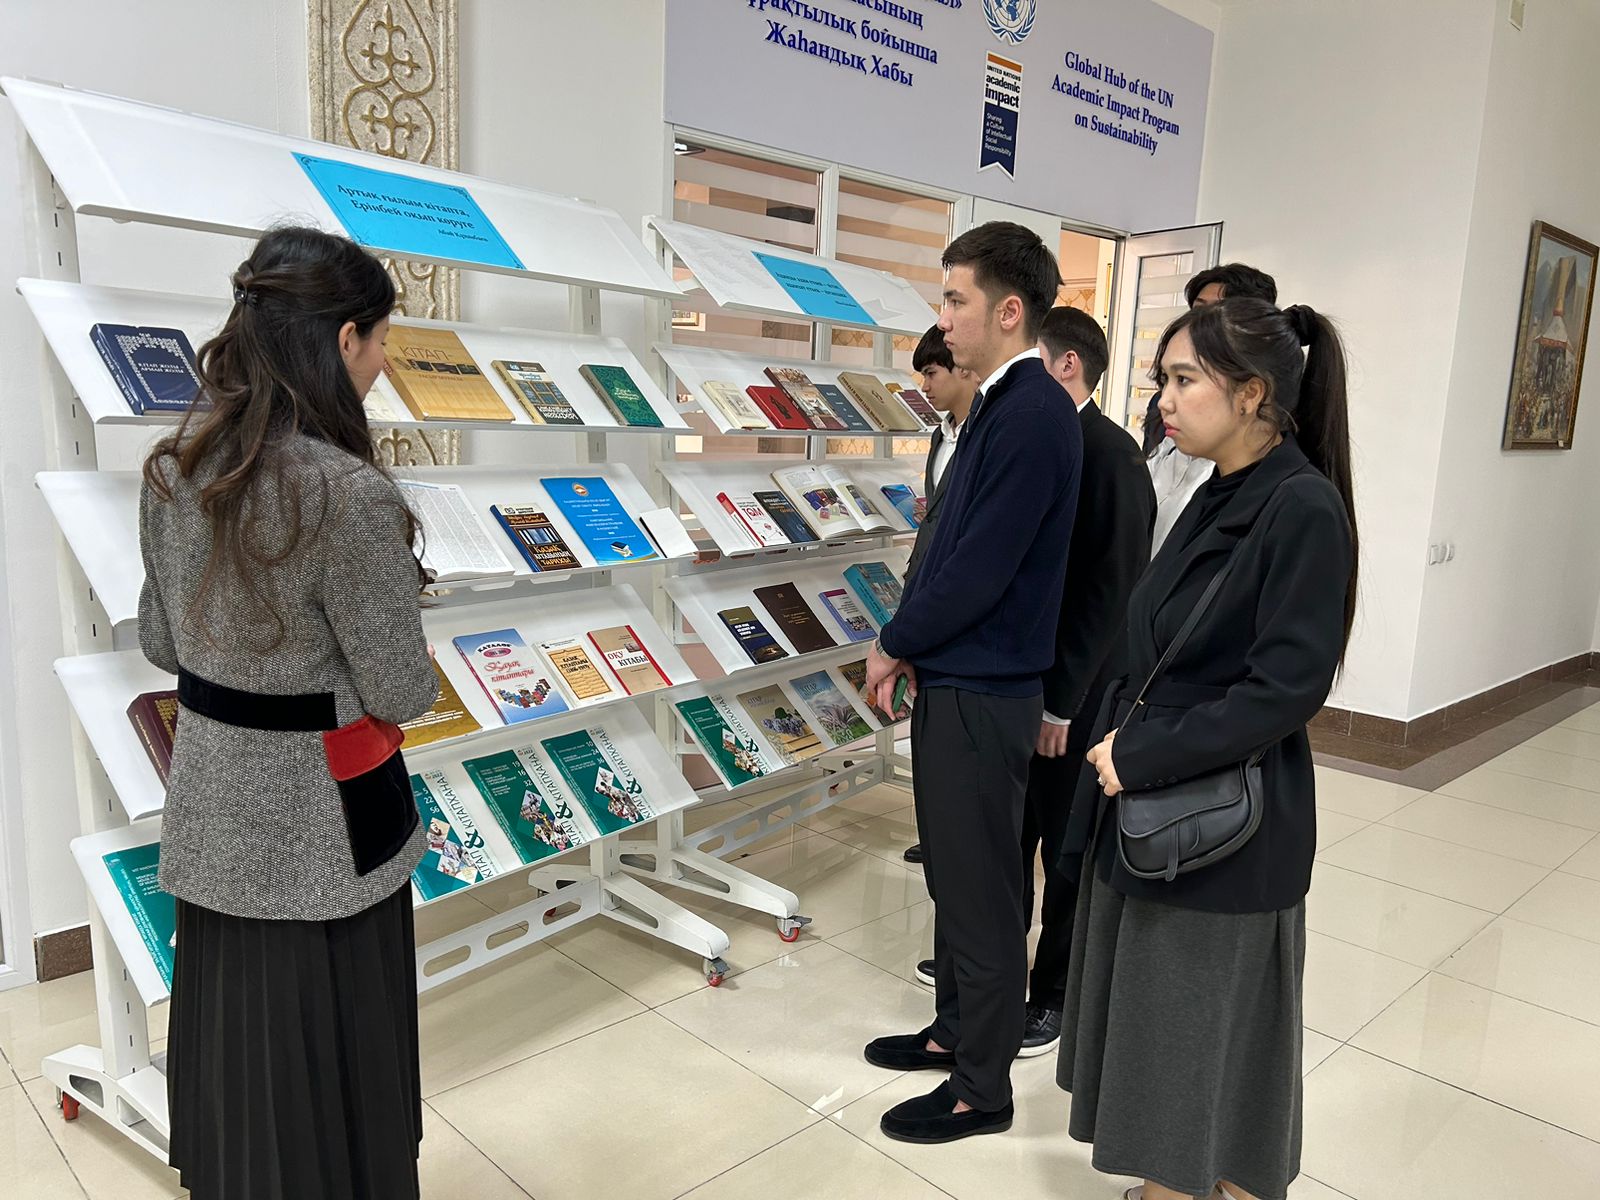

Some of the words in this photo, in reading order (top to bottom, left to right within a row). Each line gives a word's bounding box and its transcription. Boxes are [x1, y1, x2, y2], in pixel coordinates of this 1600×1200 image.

[764, 19, 867, 75] Жаһандық
[870, 54, 914, 87] Хабы
[861, 19, 938, 64] бойынша
[986, 74, 1021, 94] academic
[1065, 51, 1102, 80] Global
[1104, 66, 1127, 89] Hub
[1128, 78, 1140, 95] of
[1141, 82, 1156, 102] the
[1157, 88, 1174, 109] UN
[985, 83, 1020, 109] impact
[1051, 73, 1105, 108] Academic
[1106, 94, 1141, 120] Impact
[1142, 107, 1180, 136] Program
[990, 121, 1005, 132] Culture
[1074, 113, 1089, 129] on
[1090, 114, 1158, 156] Sustainability
[618, 655, 649, 667] КІТАБЫ
[437, 776, 474, 829] КІТАПХАНА
[555, 800, 574, 819] &
[464, 829, 485, 849] &
[469, 849, 494, 879] КІТАП
